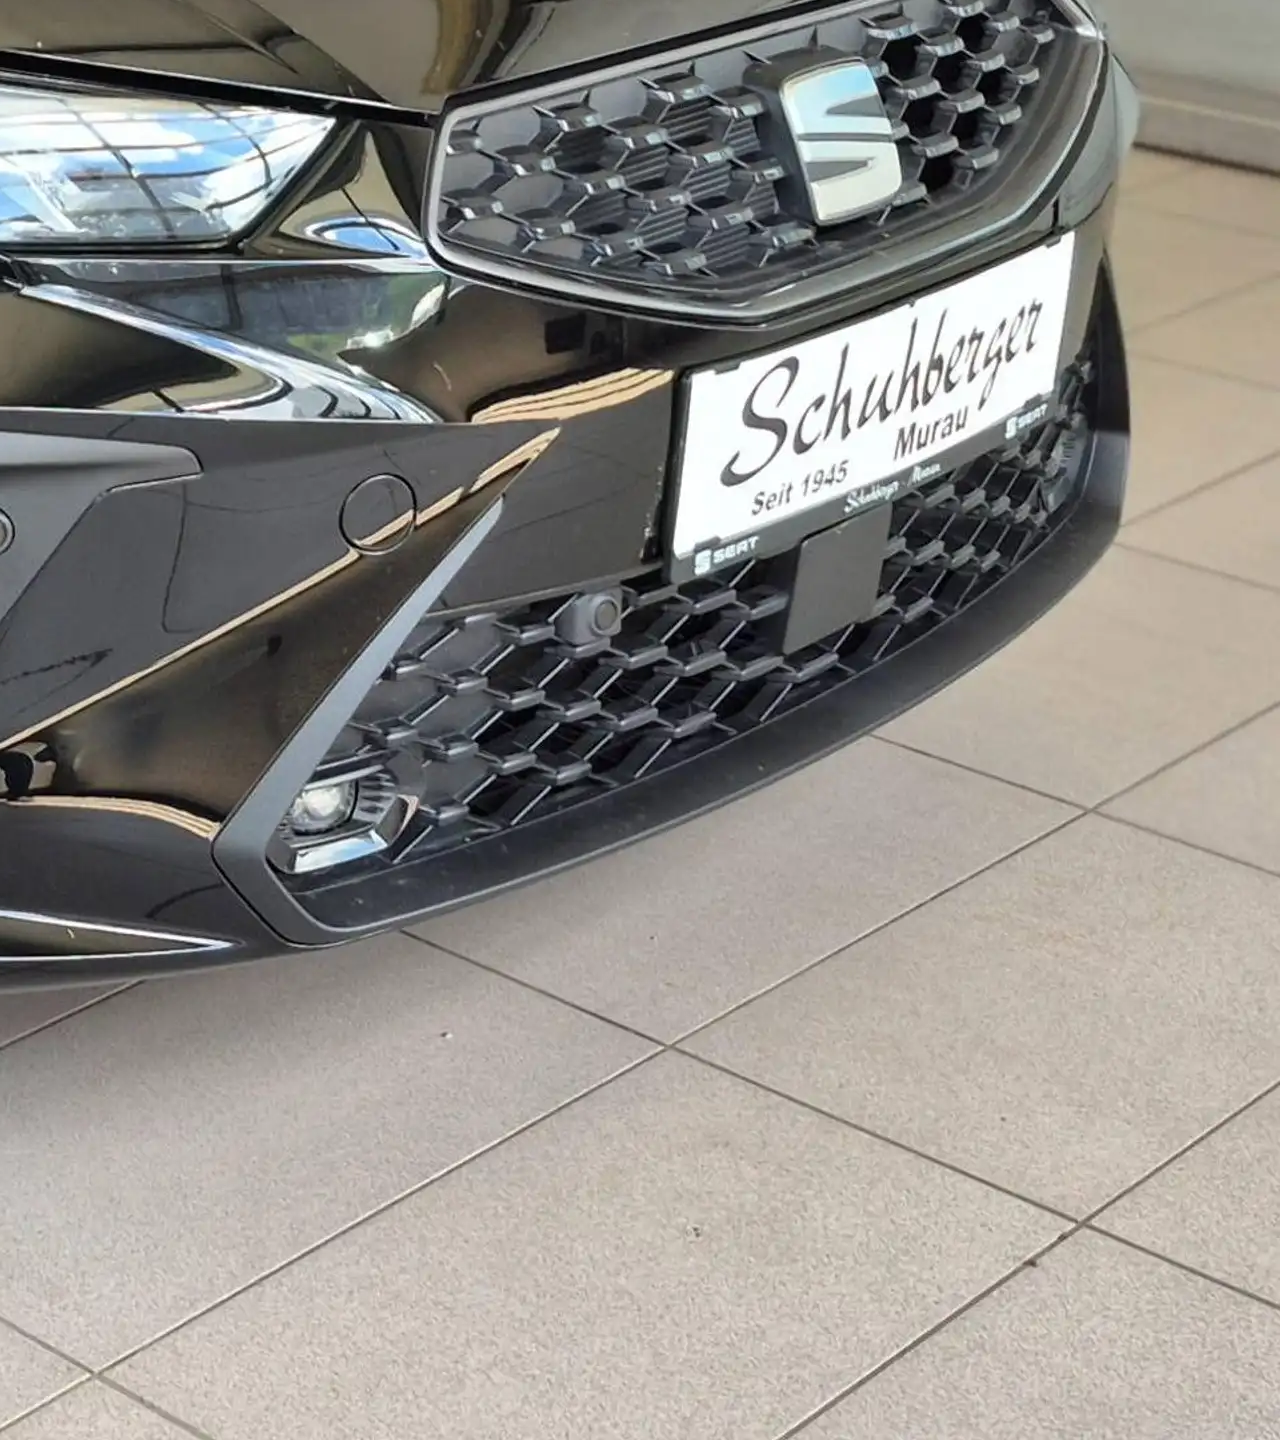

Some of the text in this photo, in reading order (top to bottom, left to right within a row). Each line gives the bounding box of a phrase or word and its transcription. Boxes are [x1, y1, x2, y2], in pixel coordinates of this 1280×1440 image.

[720, 298, 1044, 487] Schuhberger
[893, 404, 969, 462] Murau
[751, 459, 849, 516] Seit 1945
[713, 535, 759, 564] SEAT
